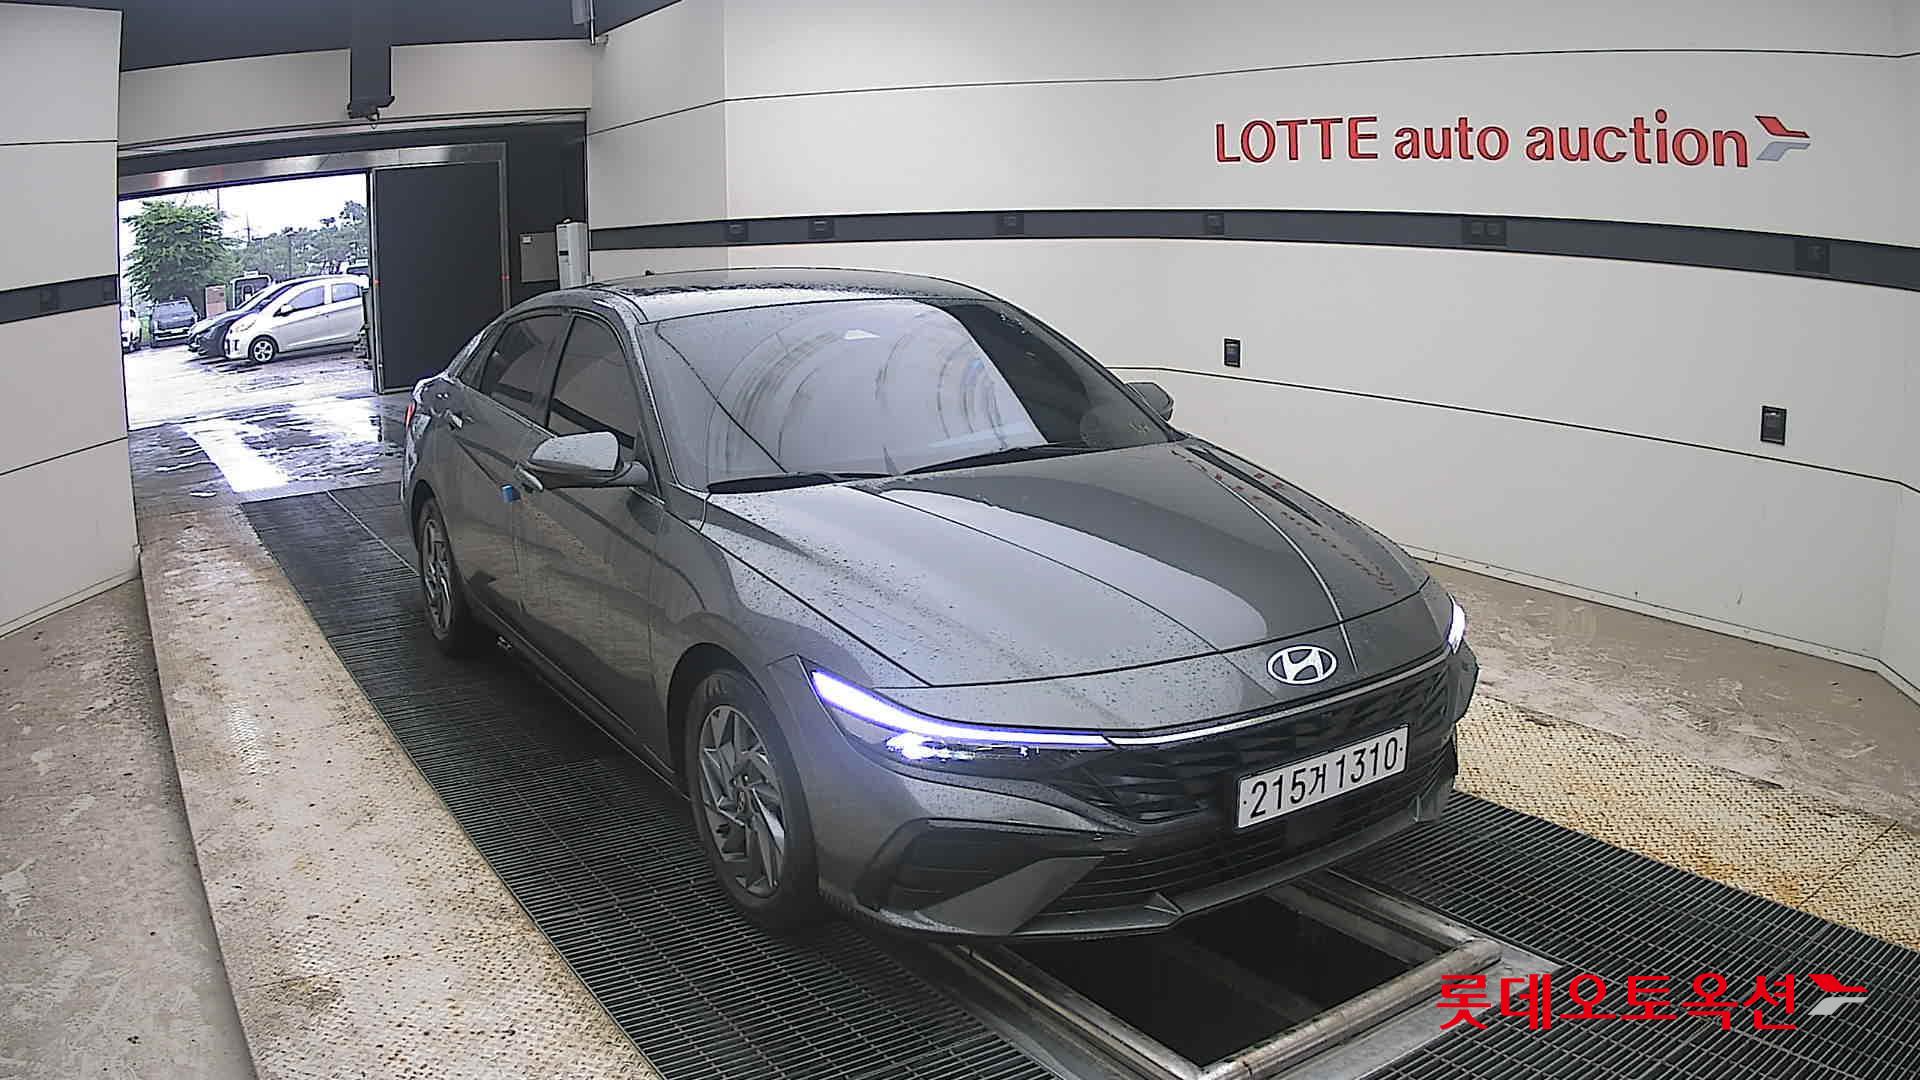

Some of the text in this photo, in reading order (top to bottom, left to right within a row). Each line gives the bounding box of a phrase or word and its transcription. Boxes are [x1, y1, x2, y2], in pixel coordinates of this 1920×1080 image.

[1215, 108, 1750, 168] LOTTE auto auction
[1335, 736, 1399, 789] 1310
